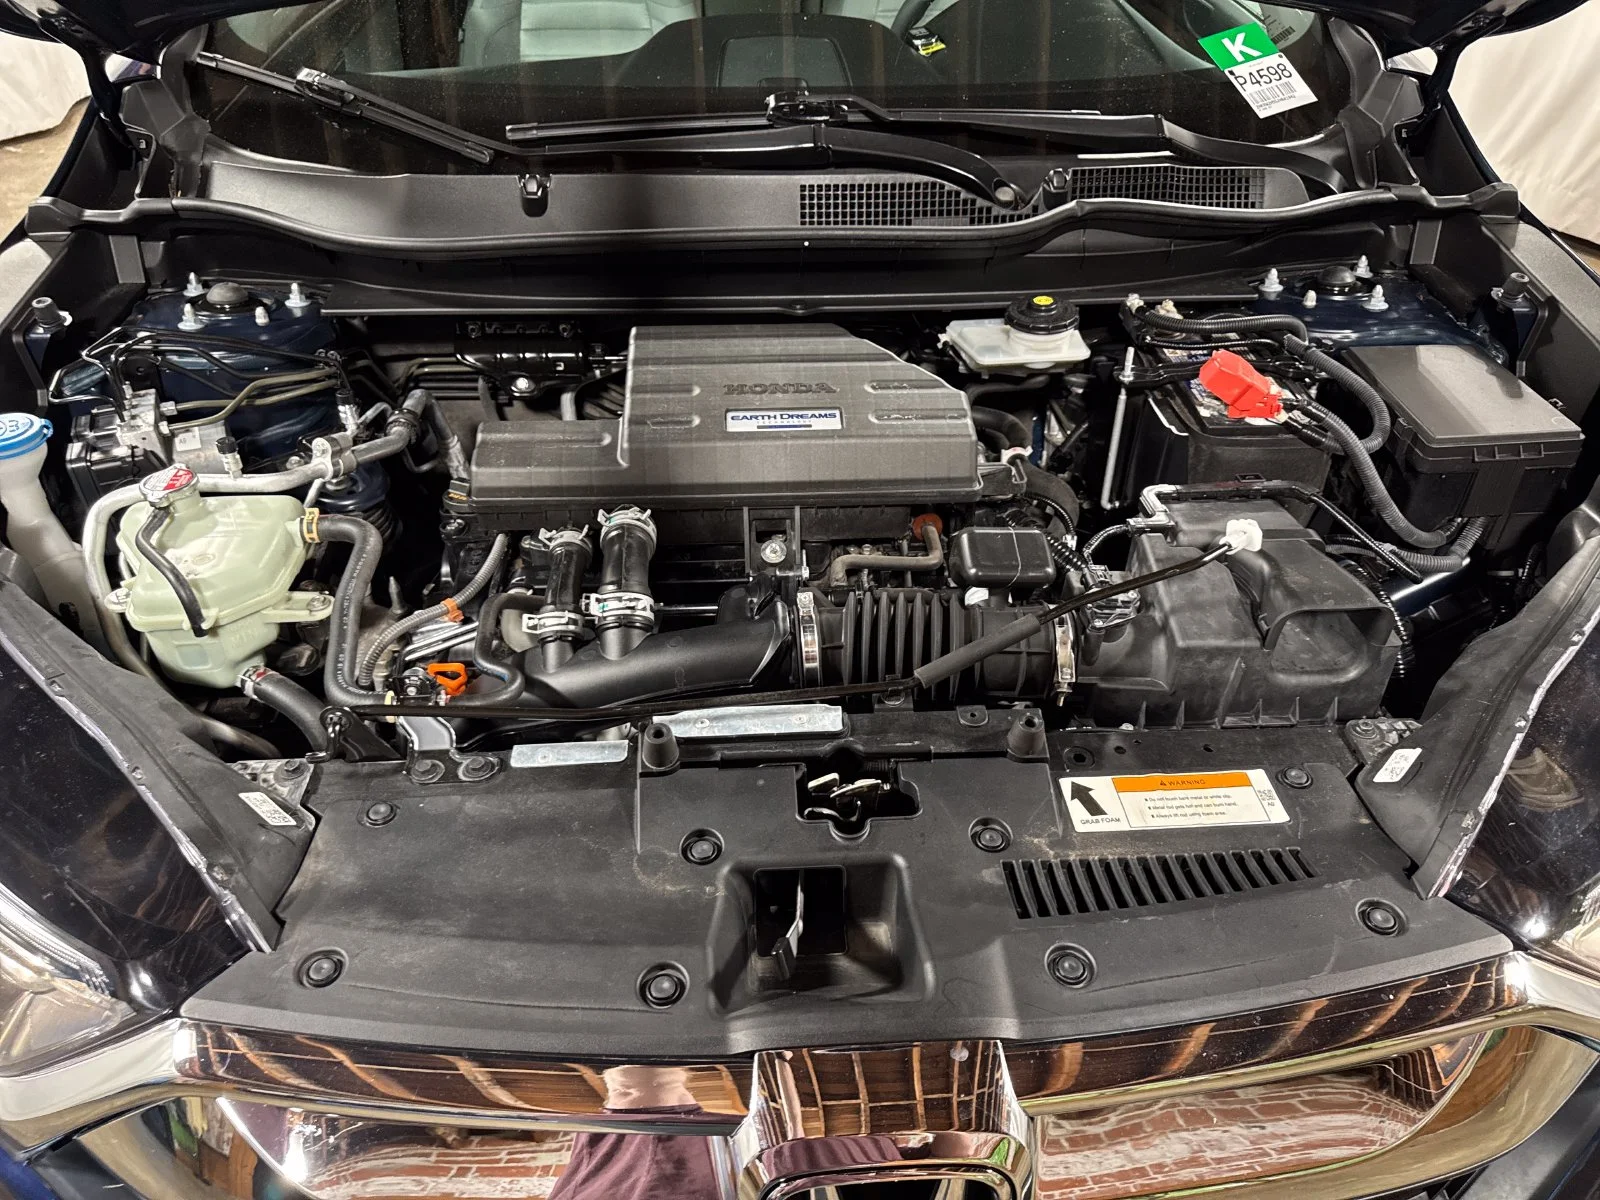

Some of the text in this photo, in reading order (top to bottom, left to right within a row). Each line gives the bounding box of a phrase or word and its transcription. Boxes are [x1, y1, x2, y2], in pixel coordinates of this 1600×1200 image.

[1221, 32, 1262, 62] K
[1234, 63, 1293, 92] P4598
[723, 383, 836, 394] HONDA
[780, 412, 837, 420] DREAMS
